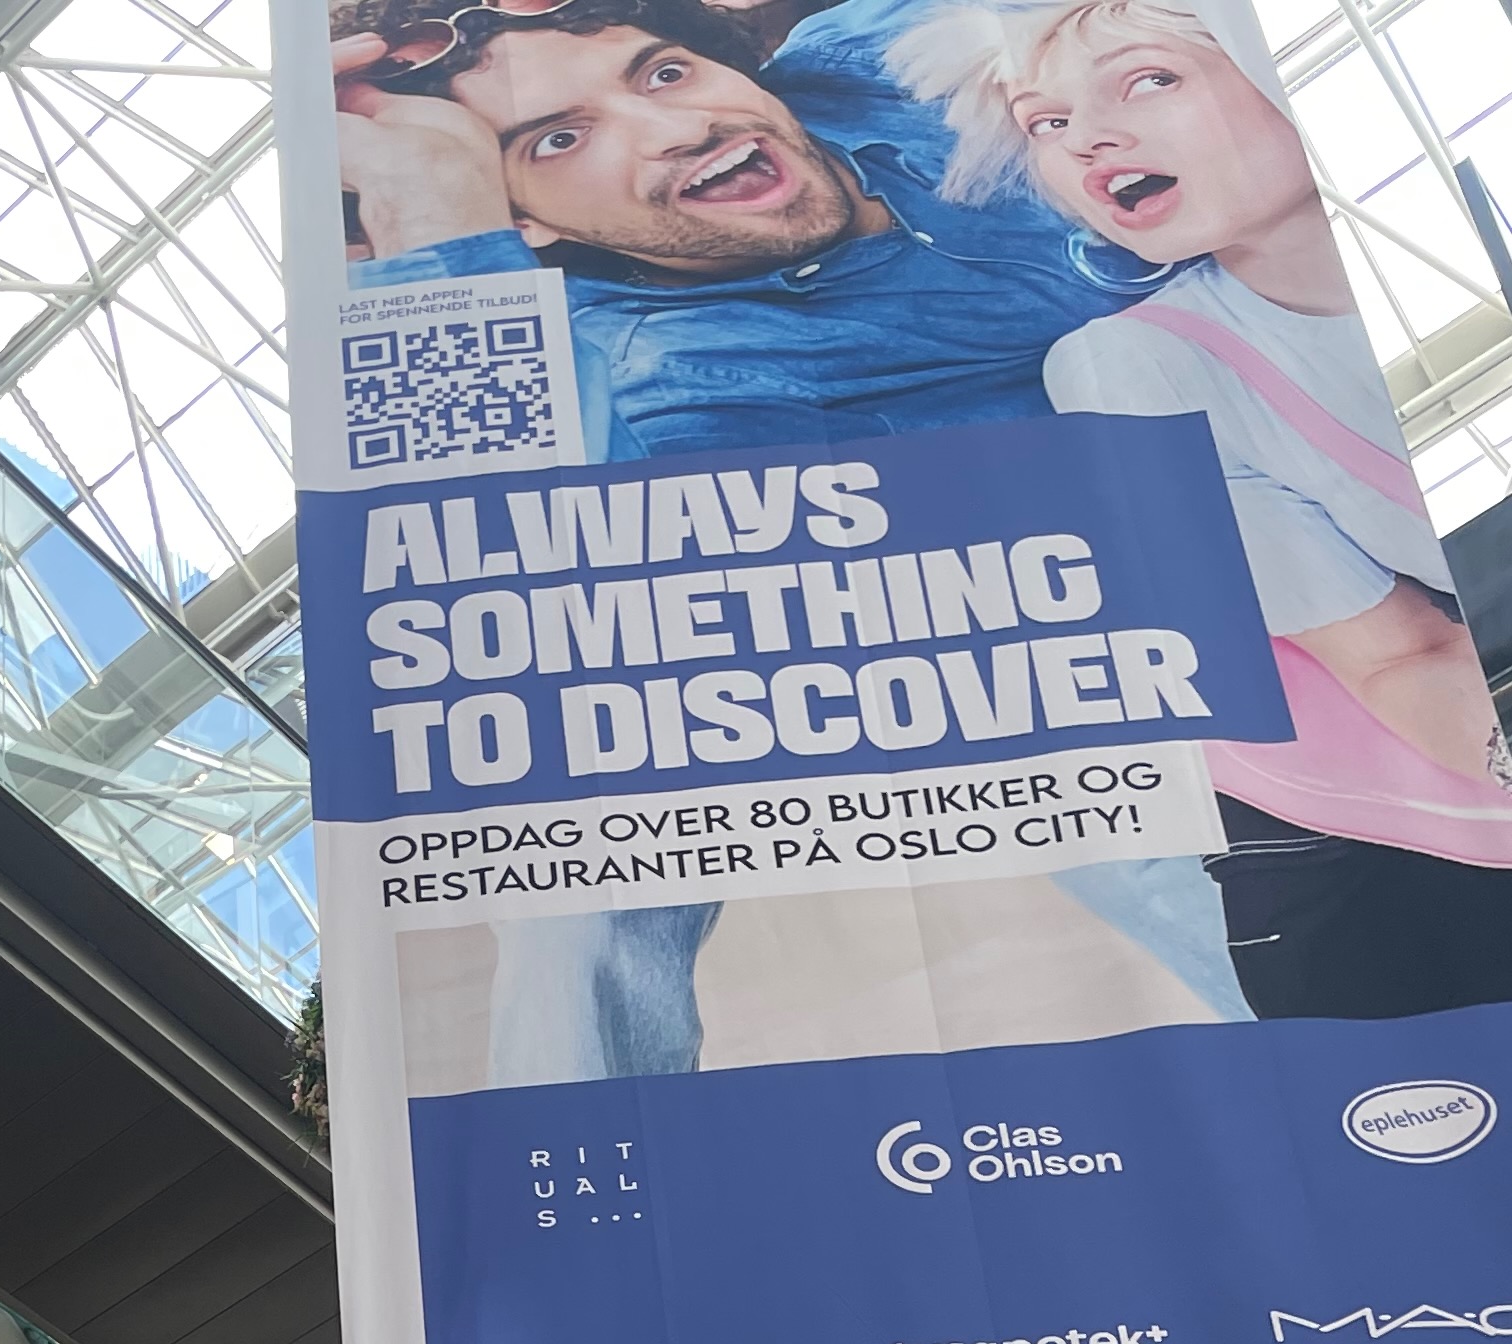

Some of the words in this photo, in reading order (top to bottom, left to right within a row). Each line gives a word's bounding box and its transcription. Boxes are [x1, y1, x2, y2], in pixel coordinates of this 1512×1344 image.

[339, 299, 378, 314] LAST
[382, 294, 416, 308] NED
[420, 288, 473, 303] APPEN
[340, 313, 372, 326] FOR
[376, 300, 473, 322] SPENNENDE
[476, 293, 538, 308] TILBUD!
[363, 461, 889, 593] ALWAYS
[366, 534, 1103, 690] SOMETHING
[372, 692, 532, 794] TO
[560, 628, 1213, 777] DISCOVER
[378, 818, 584, 865] OPPDAG
[599, 804, 736, 842] OVER
[749, 797, 813, 830] 80
[828, 773, 1063, 823] BUTIKKER
[1077, 761, 1163, 794] OG
[382, 843, 759, 908] RESTAURANTER
[772, 827, 842, 869] PÅ
[855, 823, 997, 863] OSLO
[1014, 803, 1145, 848] CITY!
[962, 1122, 1063, 1153] Clas
[1361, 1095, 1475, 1136] eplehuset
[968, 1150, 1123, 1183] Ohlson
